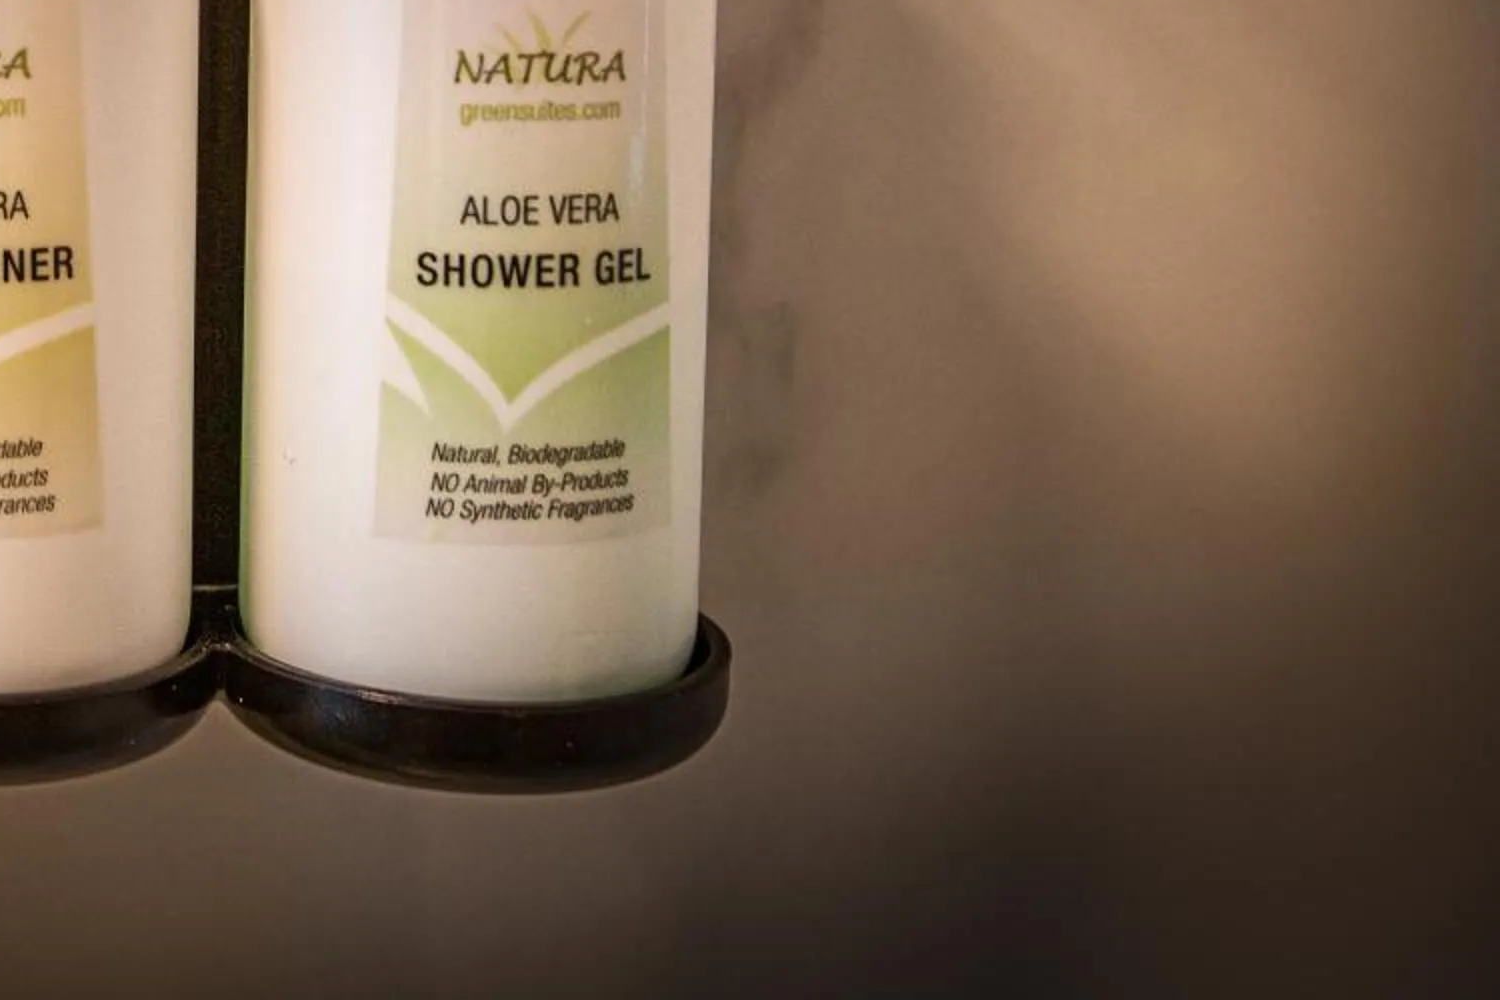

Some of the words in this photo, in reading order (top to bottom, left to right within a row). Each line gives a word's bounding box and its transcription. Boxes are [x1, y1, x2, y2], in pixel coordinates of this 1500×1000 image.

[454, 50, 626, 86] NATURA
[460, 101, 621, 126] greensuites.com
[460, 195, 539, 226] ALOE
[549, 193, 619, 224] VERA
[417, 252, 579, 288] SHOWER
[595, 248, 651, 285] GEL
[432, 442, 501, 466] Natural,
[508, 439, 626, 467] Biodegradable
[431, 472, 459, 492] NO
[464, 474, 527, 494] Animal
[532, 468, 629, 497] By-Products
[426, 498, 454, 518] NO
[459, 500, 542, 524] Synthetic
[548, 494, 634, 521] Fragrances
